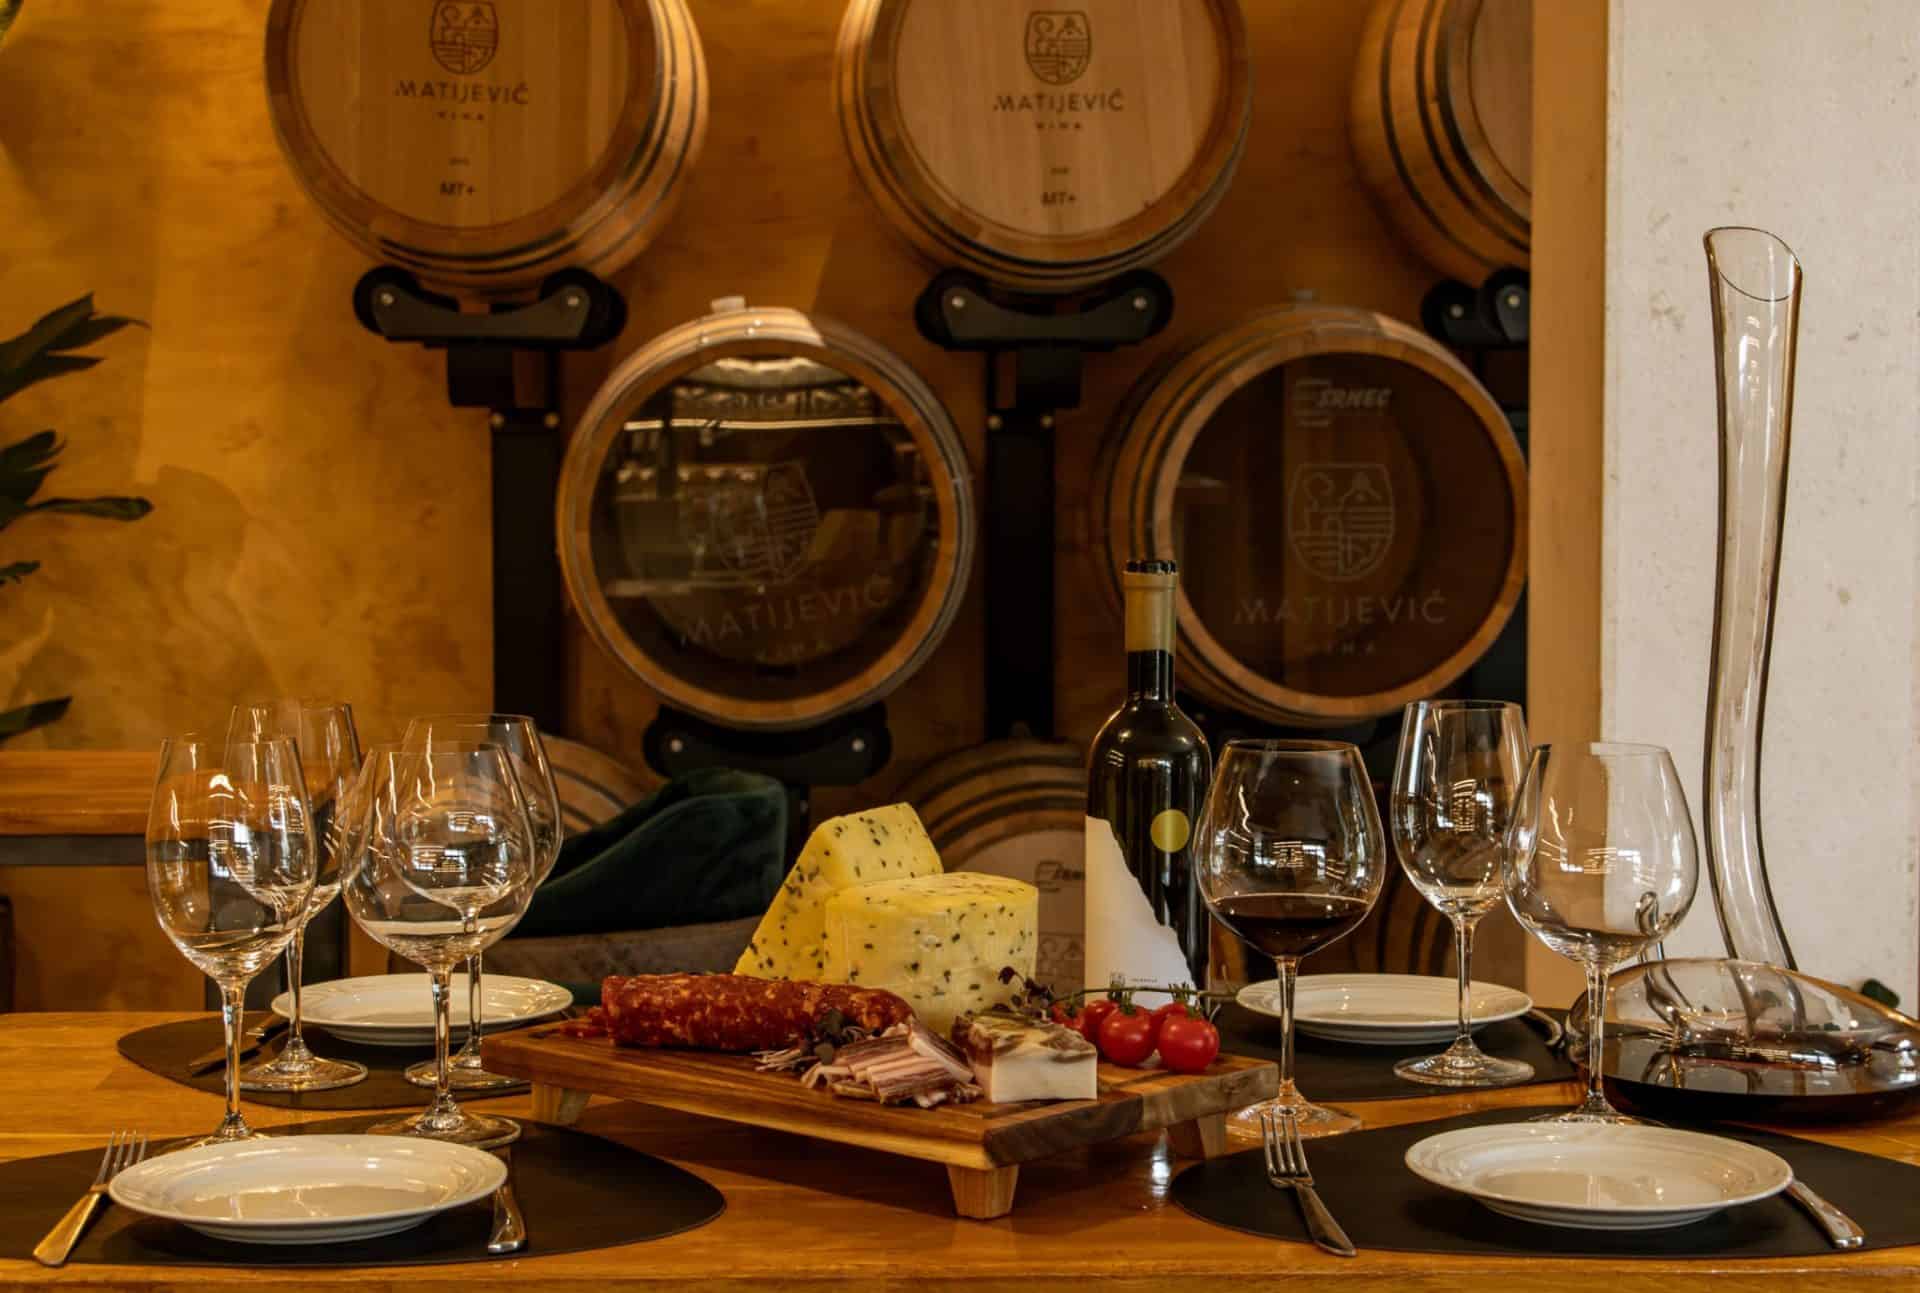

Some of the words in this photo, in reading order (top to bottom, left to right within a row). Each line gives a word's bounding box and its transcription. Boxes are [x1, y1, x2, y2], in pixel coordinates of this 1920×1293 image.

[392, 80, 529, 105] MATIJEVIĆ
[992, 88, 1125, 114] MATIJEVIĆ
[1232, 588, 1449, 625] MATIJEVIĆ
